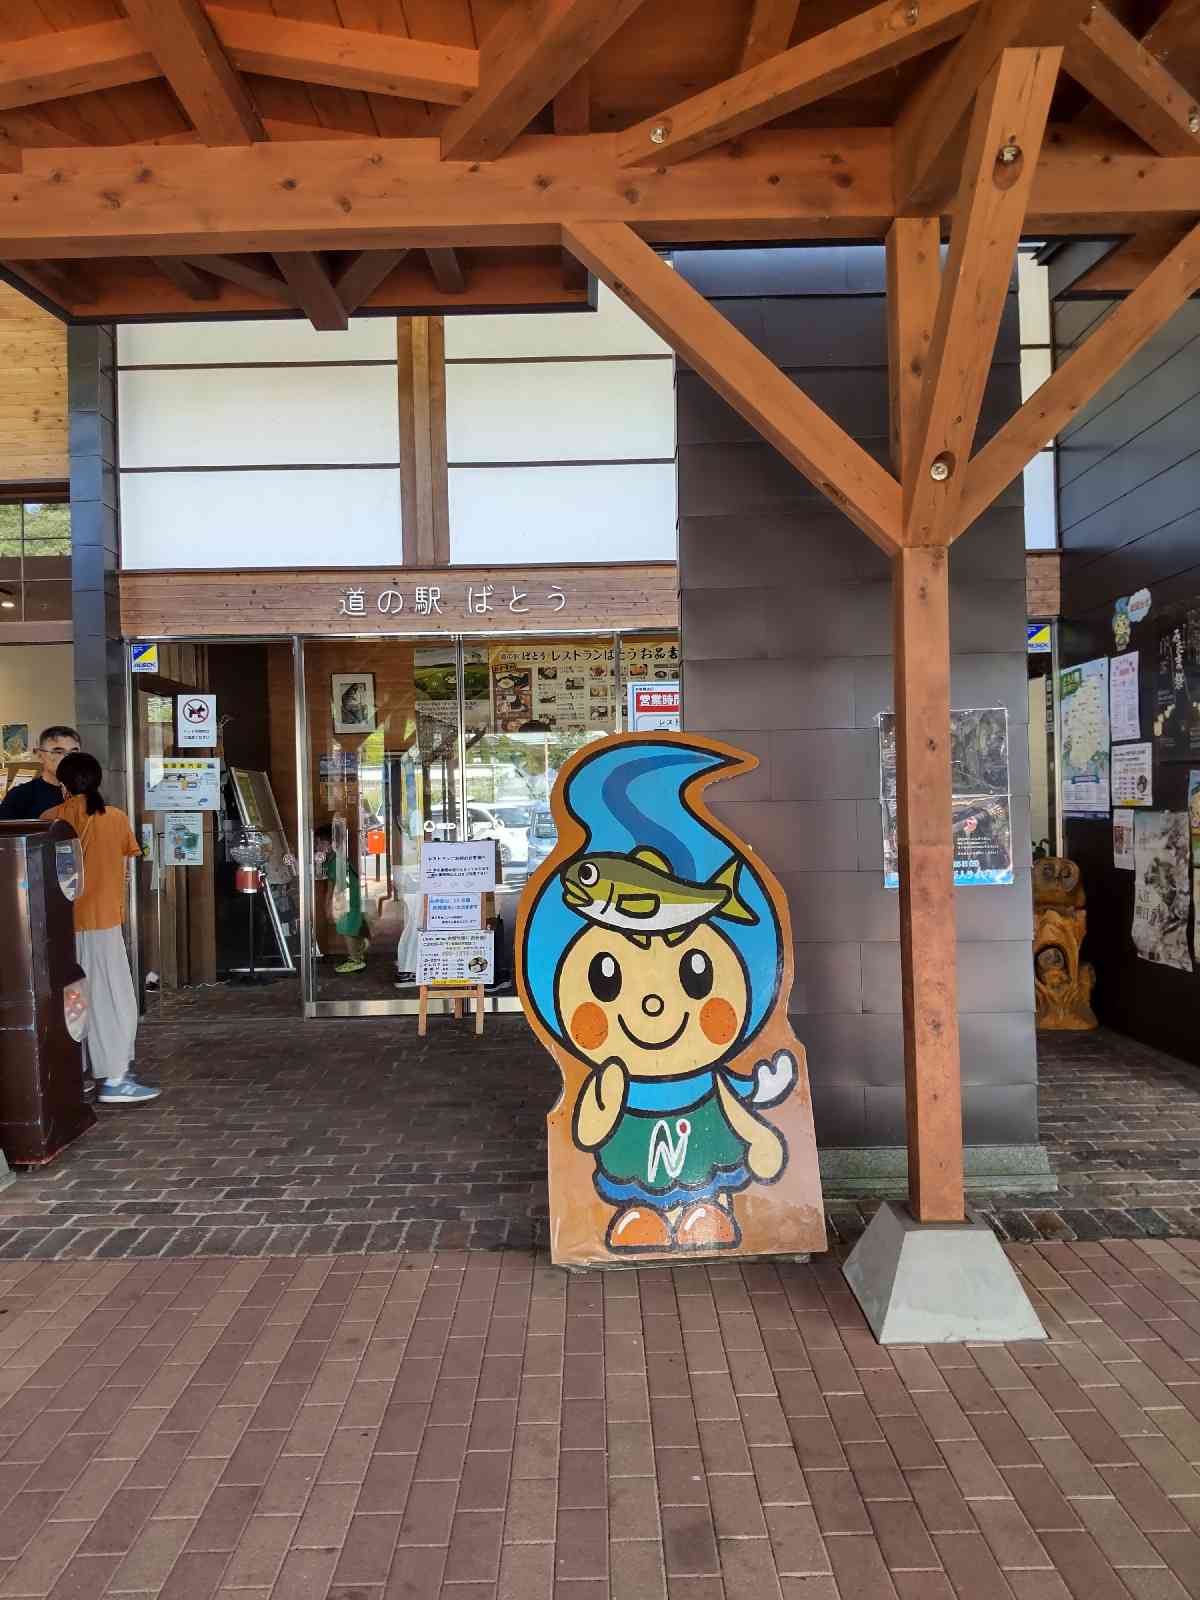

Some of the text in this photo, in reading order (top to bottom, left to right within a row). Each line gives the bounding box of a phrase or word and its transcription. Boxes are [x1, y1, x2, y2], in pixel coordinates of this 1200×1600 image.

[339, 585, 567, 615] 道の駅 ばとう
